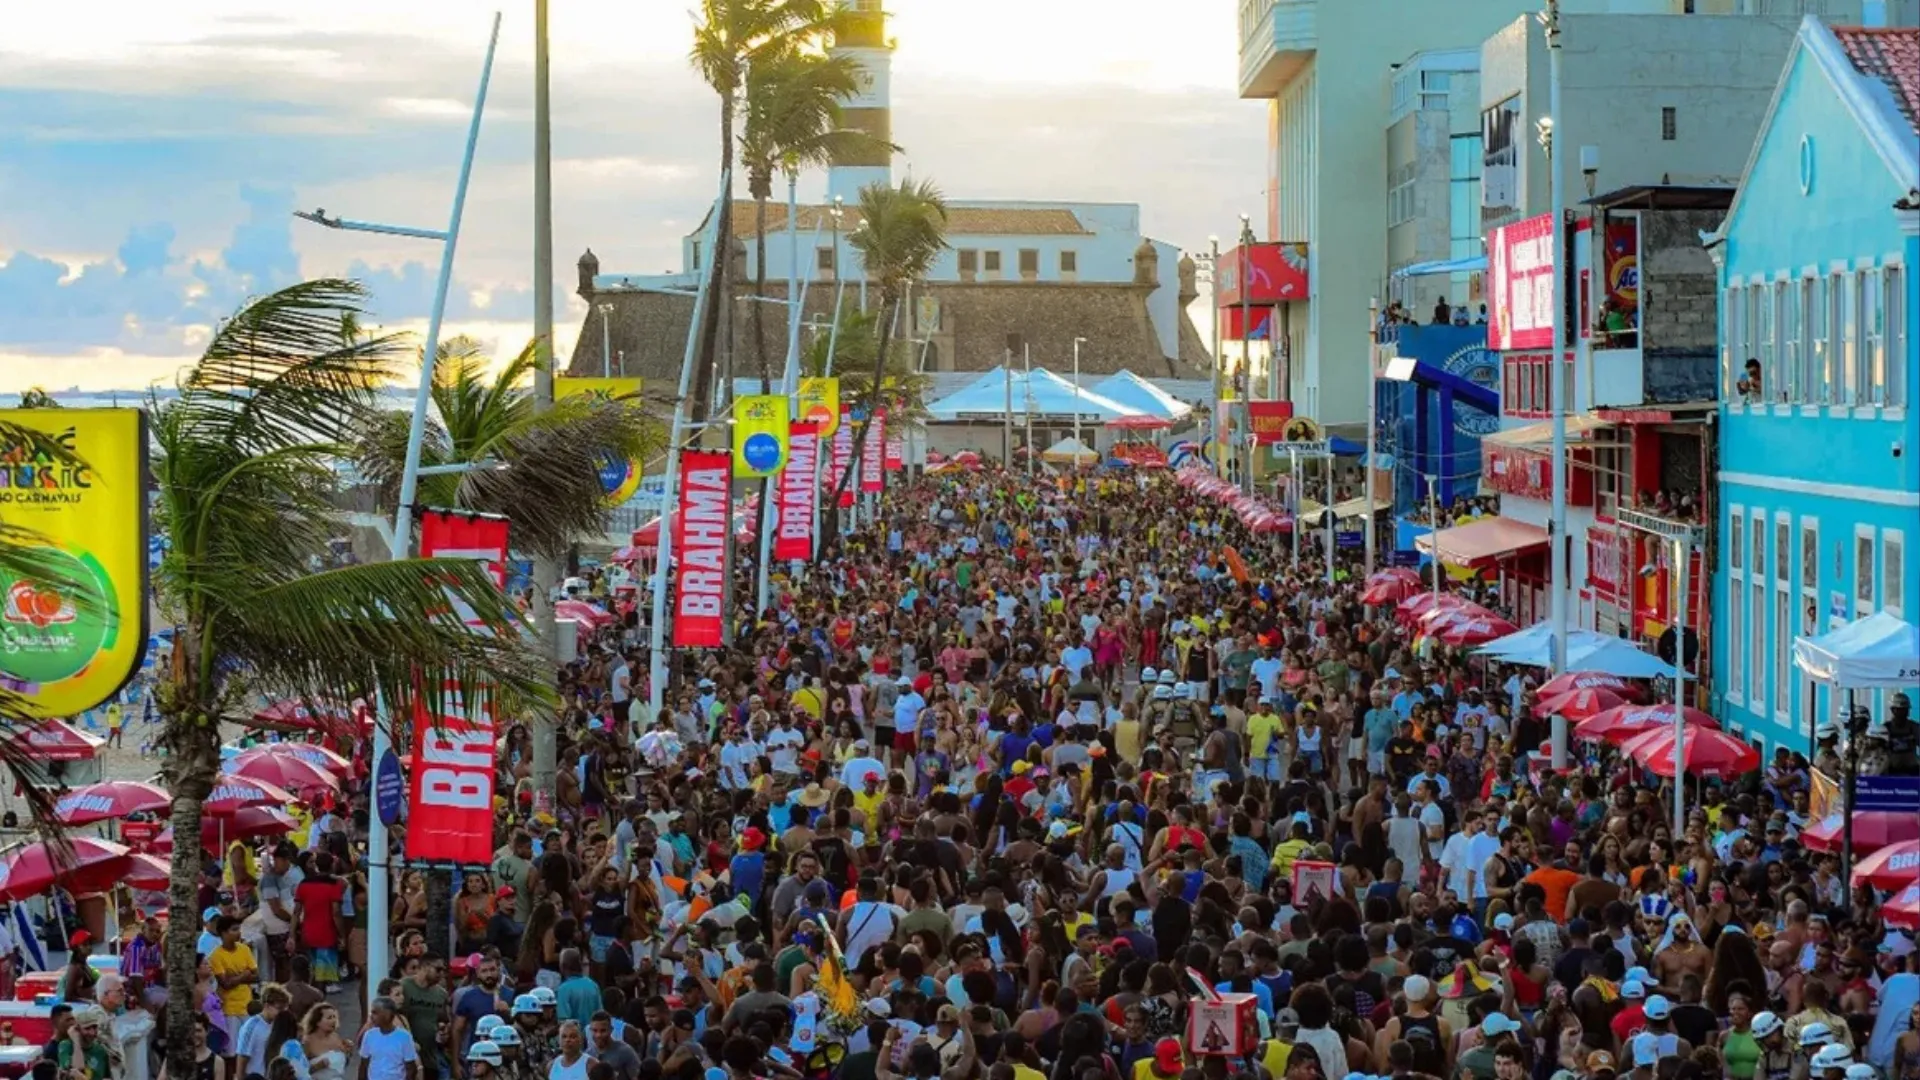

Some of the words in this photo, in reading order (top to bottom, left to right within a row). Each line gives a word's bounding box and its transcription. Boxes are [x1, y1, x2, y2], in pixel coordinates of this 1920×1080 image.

[16, 492, 82, 503] CARNAVAIS
[780, 434, 817, 538] BRAHMA
[681, 467, 728, 616] BRAHMA
